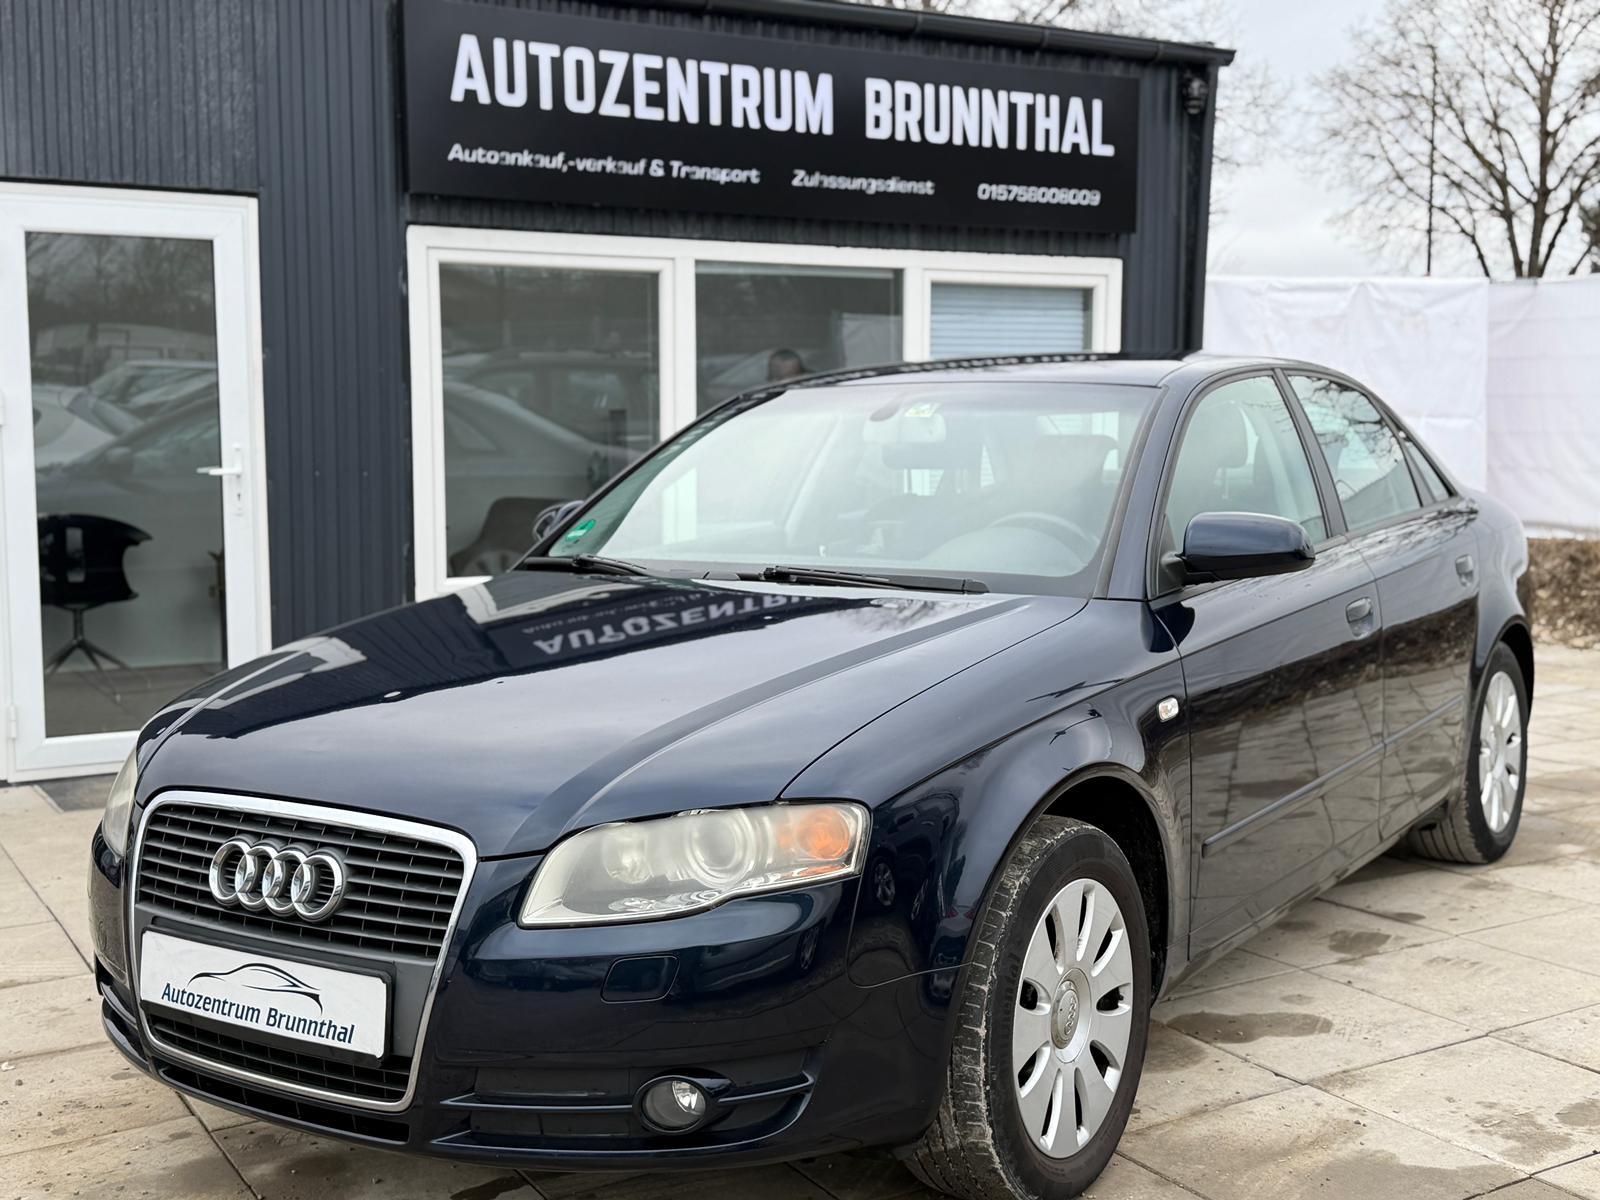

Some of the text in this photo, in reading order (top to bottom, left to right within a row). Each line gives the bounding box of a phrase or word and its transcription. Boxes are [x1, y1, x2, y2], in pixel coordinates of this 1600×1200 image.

[450, 33, 1115, 157] AUTOZENTRUM BRUNNTHAL
[648, 158, 666, 178] &
[669, 159, 761, 184] Transport
[791, 169, 935, 196] Zulassungsdienst
[161, 982, 356, 1045] Autozentrum Brunnthal
